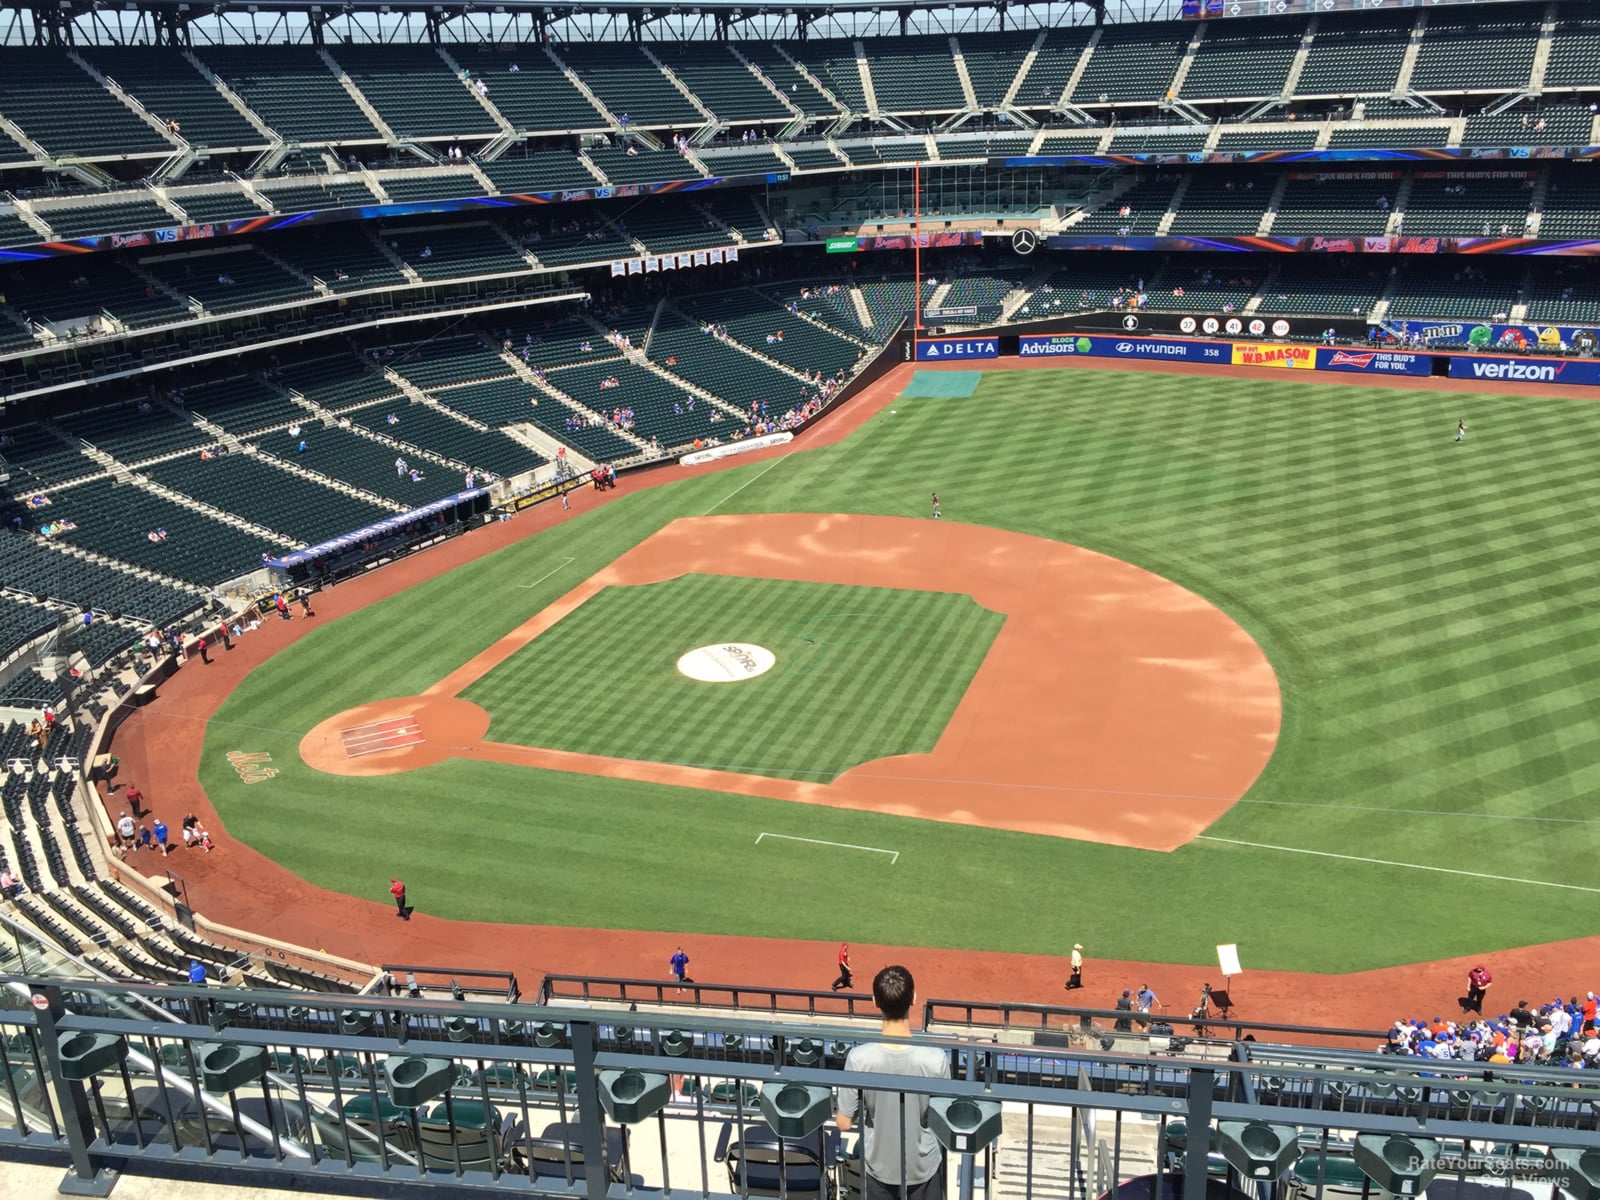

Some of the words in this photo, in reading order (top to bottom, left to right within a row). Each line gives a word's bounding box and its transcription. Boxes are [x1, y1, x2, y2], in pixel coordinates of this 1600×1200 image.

[1510, 148, 1529, 157] VS
[1187, 153, 1203, 162] VS
[595, 188, 610, 197] VS
[156, 230, 176, 241] VS
[911, 236, 928, 246] VS
[1367, 241, 1387, 250] VS
[1184, 321, 1193, 329] 37
[1206, 321, 1215, 329] 14
[1229, 322, 1239, 330] 41
[1251, 323, 1262, 331] 42
[943, 342, 995, 355] DELTA
[1021, 341, 1075, 355] Advisors
[1136, 344, 1187, 356] HYUNDAI
[1203, 348, 1220, 357] 358
[1375, 353, 1391, 362] THIS
[1393, 354, 1416, 363] BUD'S
[1375, 361, 1391, 370] FOR
[1392, 362, 1407, 371] YOU.
[1473, 361, 1556, 380] verizon
[226, 751, 280, 784] Mets
